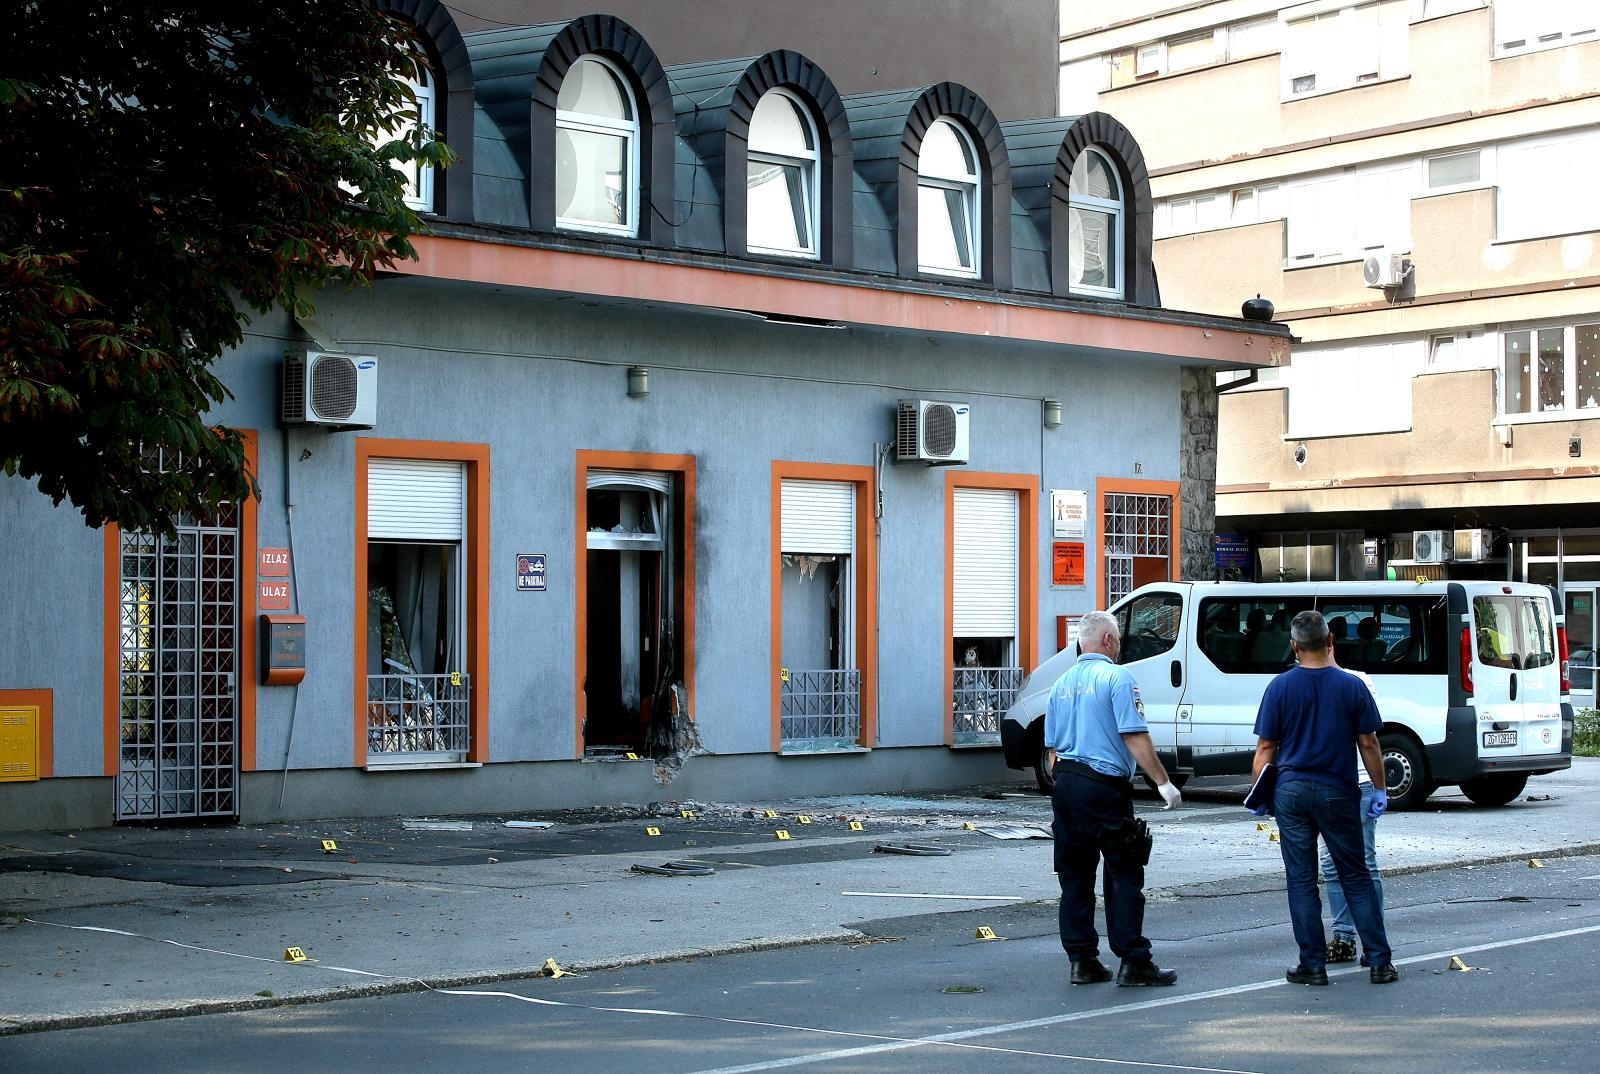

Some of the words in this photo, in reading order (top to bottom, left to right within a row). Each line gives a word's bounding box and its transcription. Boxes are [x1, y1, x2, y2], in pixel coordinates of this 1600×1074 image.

[262, 553, 288, 564] IZLAZ
[262, 586, 287, 597] ULAZ
[981, 928, 993, 936] 21
[290, 948, 304, 958] 22
